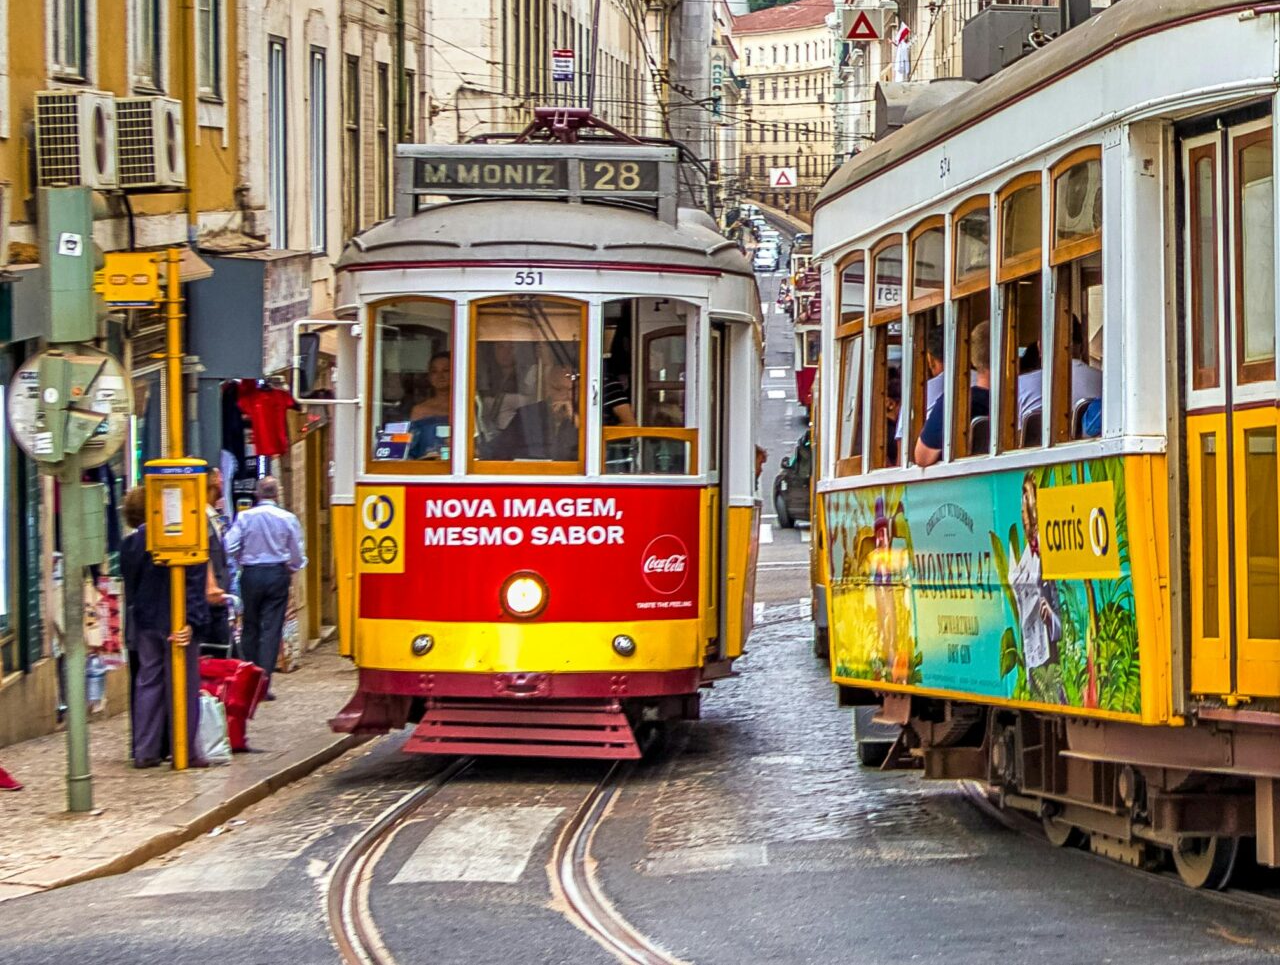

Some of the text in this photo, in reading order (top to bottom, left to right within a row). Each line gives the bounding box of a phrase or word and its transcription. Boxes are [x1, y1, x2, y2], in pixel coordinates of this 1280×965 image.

[457, 163, 555, 185] MONIZ
[594, 162, 641, 190] 28
[514, 271, 543, 286] 551
[425, 498, 624, 521] NOVA IMAGEM,
[424, 525, 625, 546] MESMO SABOR
[1045, 504, 1085, 552] carris
[915, 551, 993, 600] MONKEY 47
